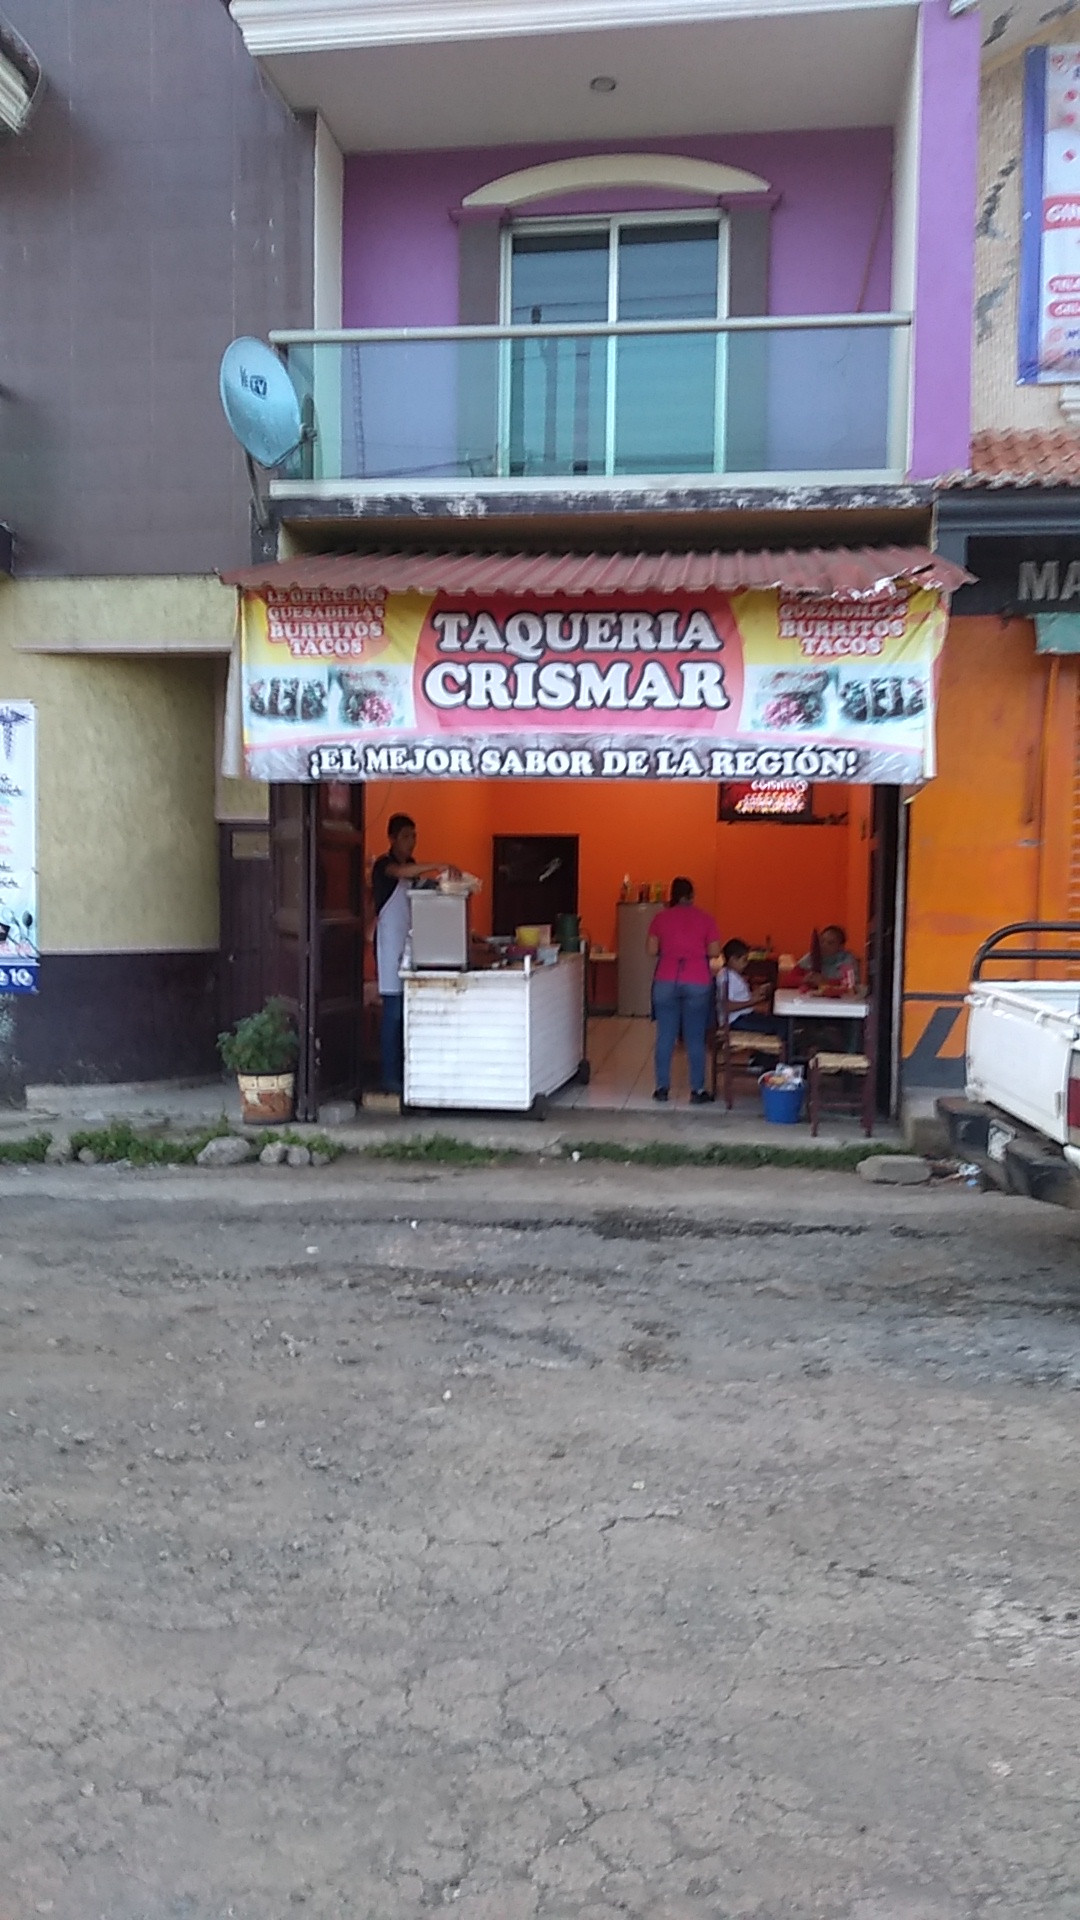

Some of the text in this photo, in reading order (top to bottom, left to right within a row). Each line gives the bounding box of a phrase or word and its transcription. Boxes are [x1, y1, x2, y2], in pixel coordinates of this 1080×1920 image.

[270, 621, 383, 638] BURRITOS
[434, 611, 722, 660] TAQUERIA
[780, 619, 905, 638] BURRITOS
[291, 638, 362, 655] TACOS
[801, 637, 881, 656] TACOS
[425, 661, 728, 709] CRISMAR
[311, 745, 859, 778] ¡EL MEJOR SABOR DE LA REGIÓN!
